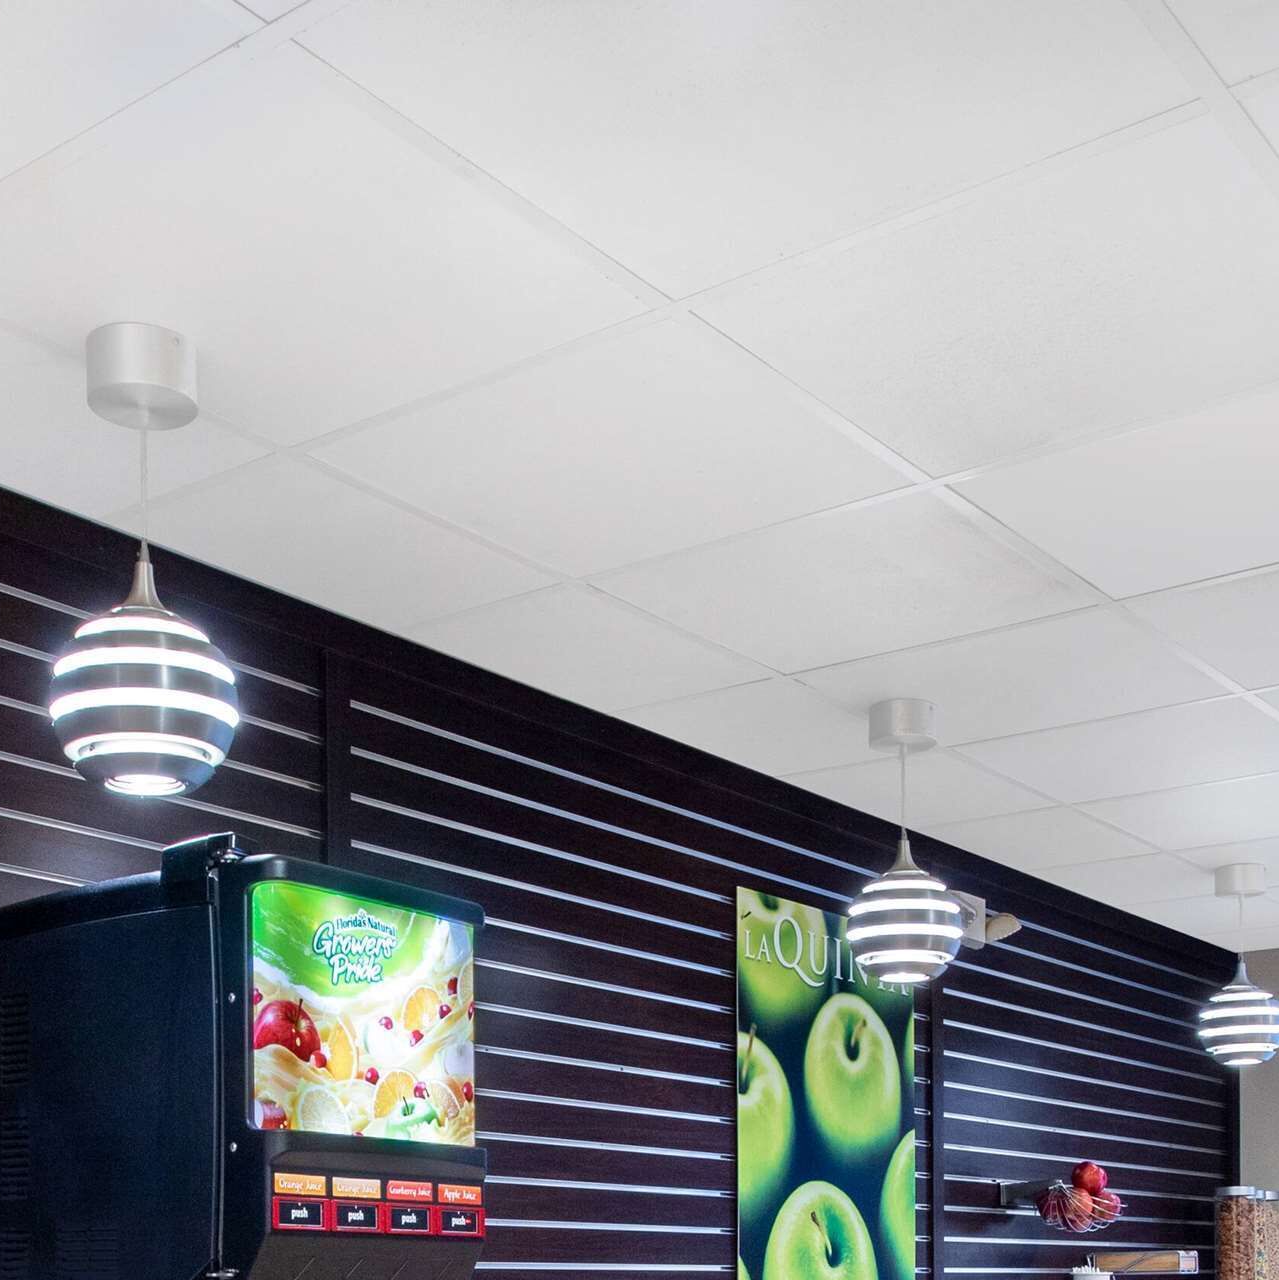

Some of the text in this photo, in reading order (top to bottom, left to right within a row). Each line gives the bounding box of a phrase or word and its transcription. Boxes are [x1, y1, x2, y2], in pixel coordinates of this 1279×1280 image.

[367, 917, 397, 937] Natural
[744, 929, 772, 964] LA
[328, 952, 384, 985] Pride
[279, 1179, 303, 1193] Orange
[443, 1188, 477, 1201] Apple Juice
[291, 1207, 308, 1220] push
[348, 1210, 365, 1223] push
[401, 1212, 417, 1225] push
[451, 1215, 466, 1227] push
